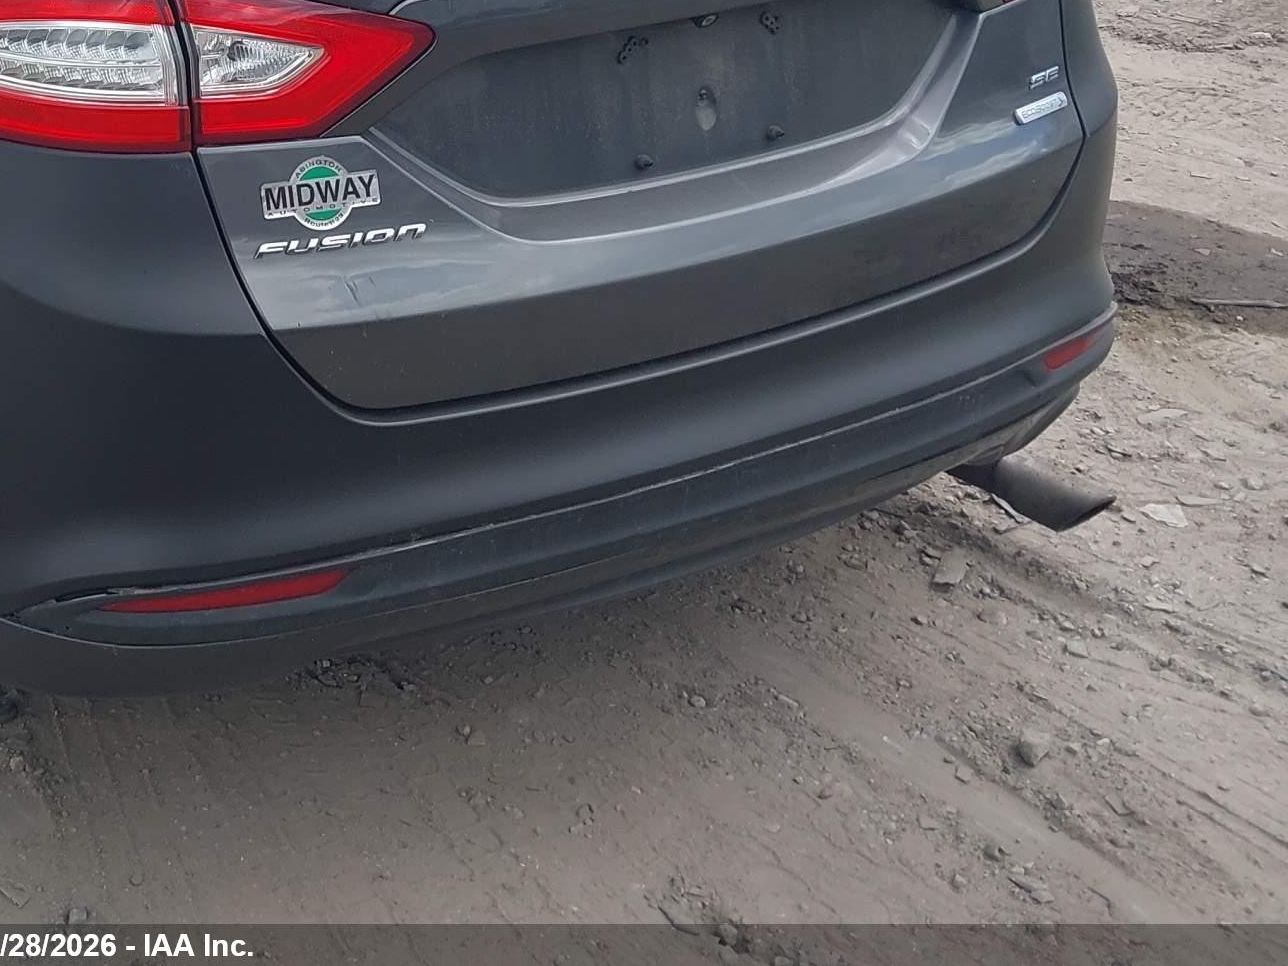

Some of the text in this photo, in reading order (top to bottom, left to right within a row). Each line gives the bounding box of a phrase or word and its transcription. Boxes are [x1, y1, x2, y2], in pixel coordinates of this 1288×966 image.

[1029, 66, 1059, 90] SE
[295, 159, 343, 179] ABINGTON
[264, 174, 375, 211] MIDWAY
[267, 197, 378, 216] AUTOMOTIVE
[253, 222, 428, 260] FUSION
